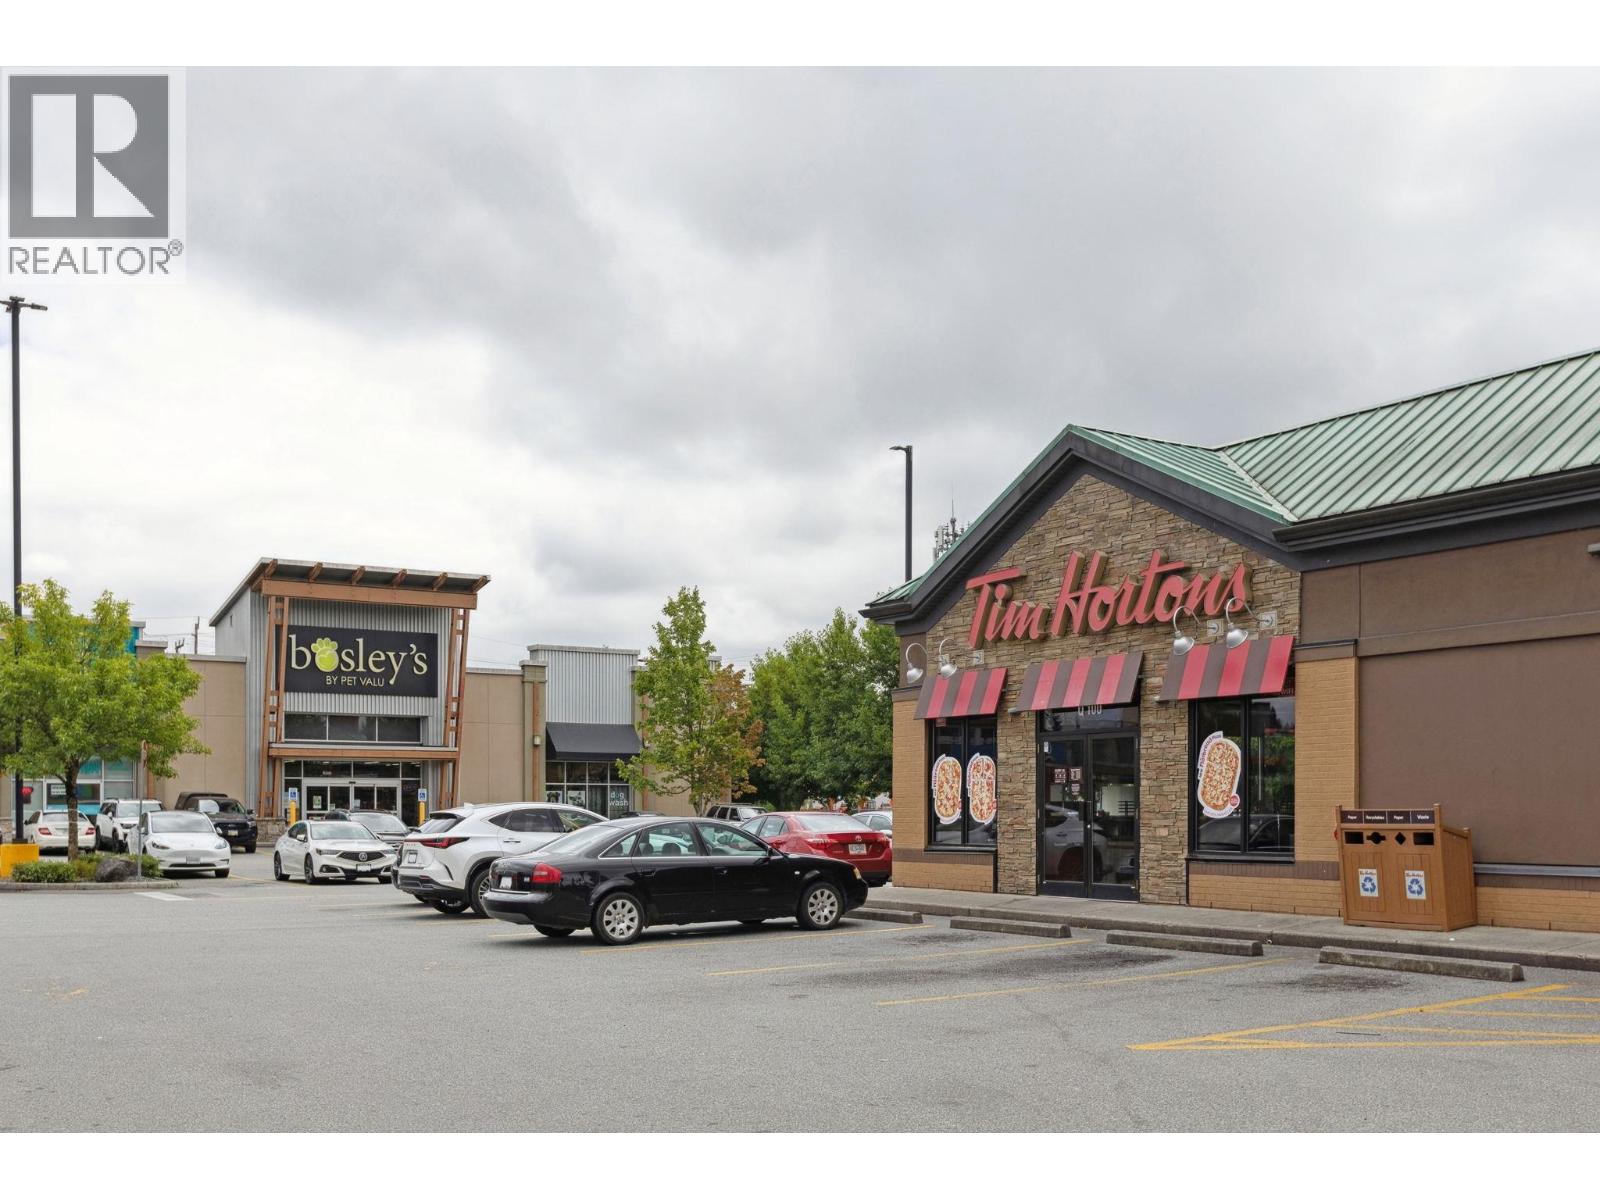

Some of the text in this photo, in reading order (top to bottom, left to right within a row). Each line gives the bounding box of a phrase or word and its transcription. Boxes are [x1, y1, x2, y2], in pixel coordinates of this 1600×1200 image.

[965, 549, 1253, 649] Tim Hortons
[326, 675, 385, 687] BY PET VALU
